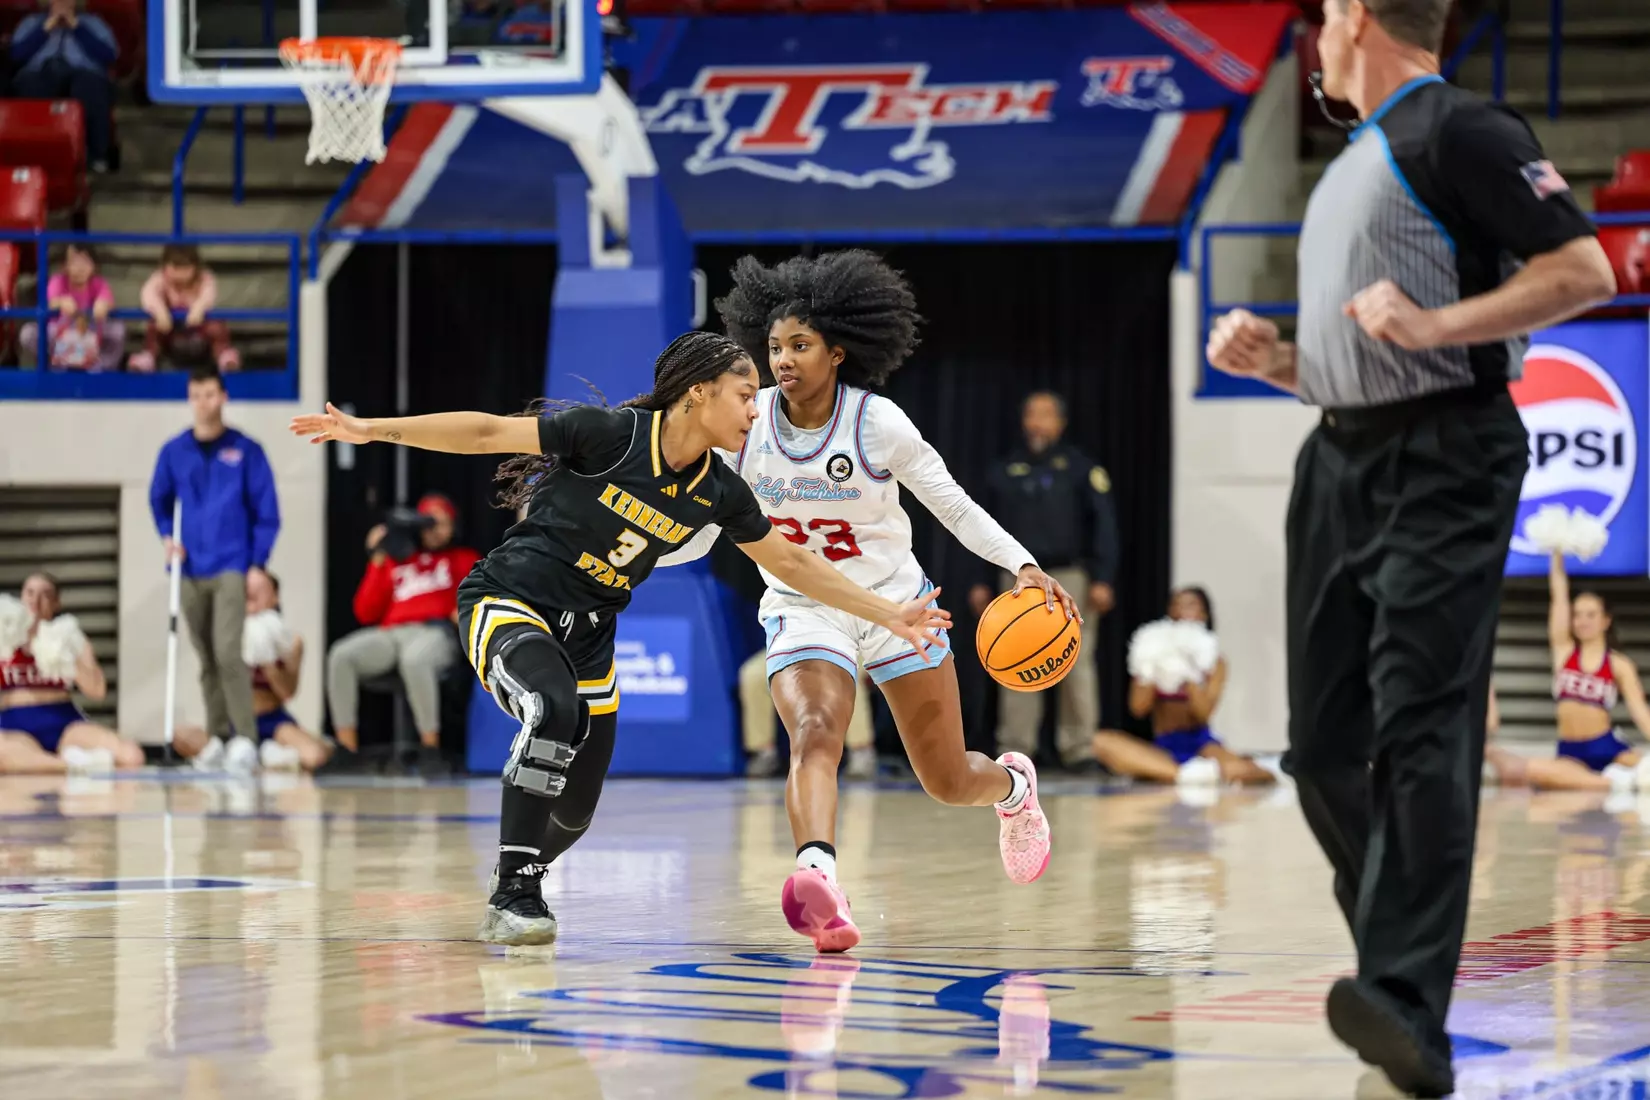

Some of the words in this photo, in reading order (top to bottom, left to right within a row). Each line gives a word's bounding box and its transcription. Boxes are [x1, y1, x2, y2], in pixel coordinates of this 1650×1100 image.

[1531, 430, 1624, 468] PSI
[751, 473, 786, 508] Lady
[788, 476, 862, 502] Techsters
[607, 527, 649, 568] 3
[574, 551, 631, 591] STAT
[1016, 636, 1077, 683] Wilson
